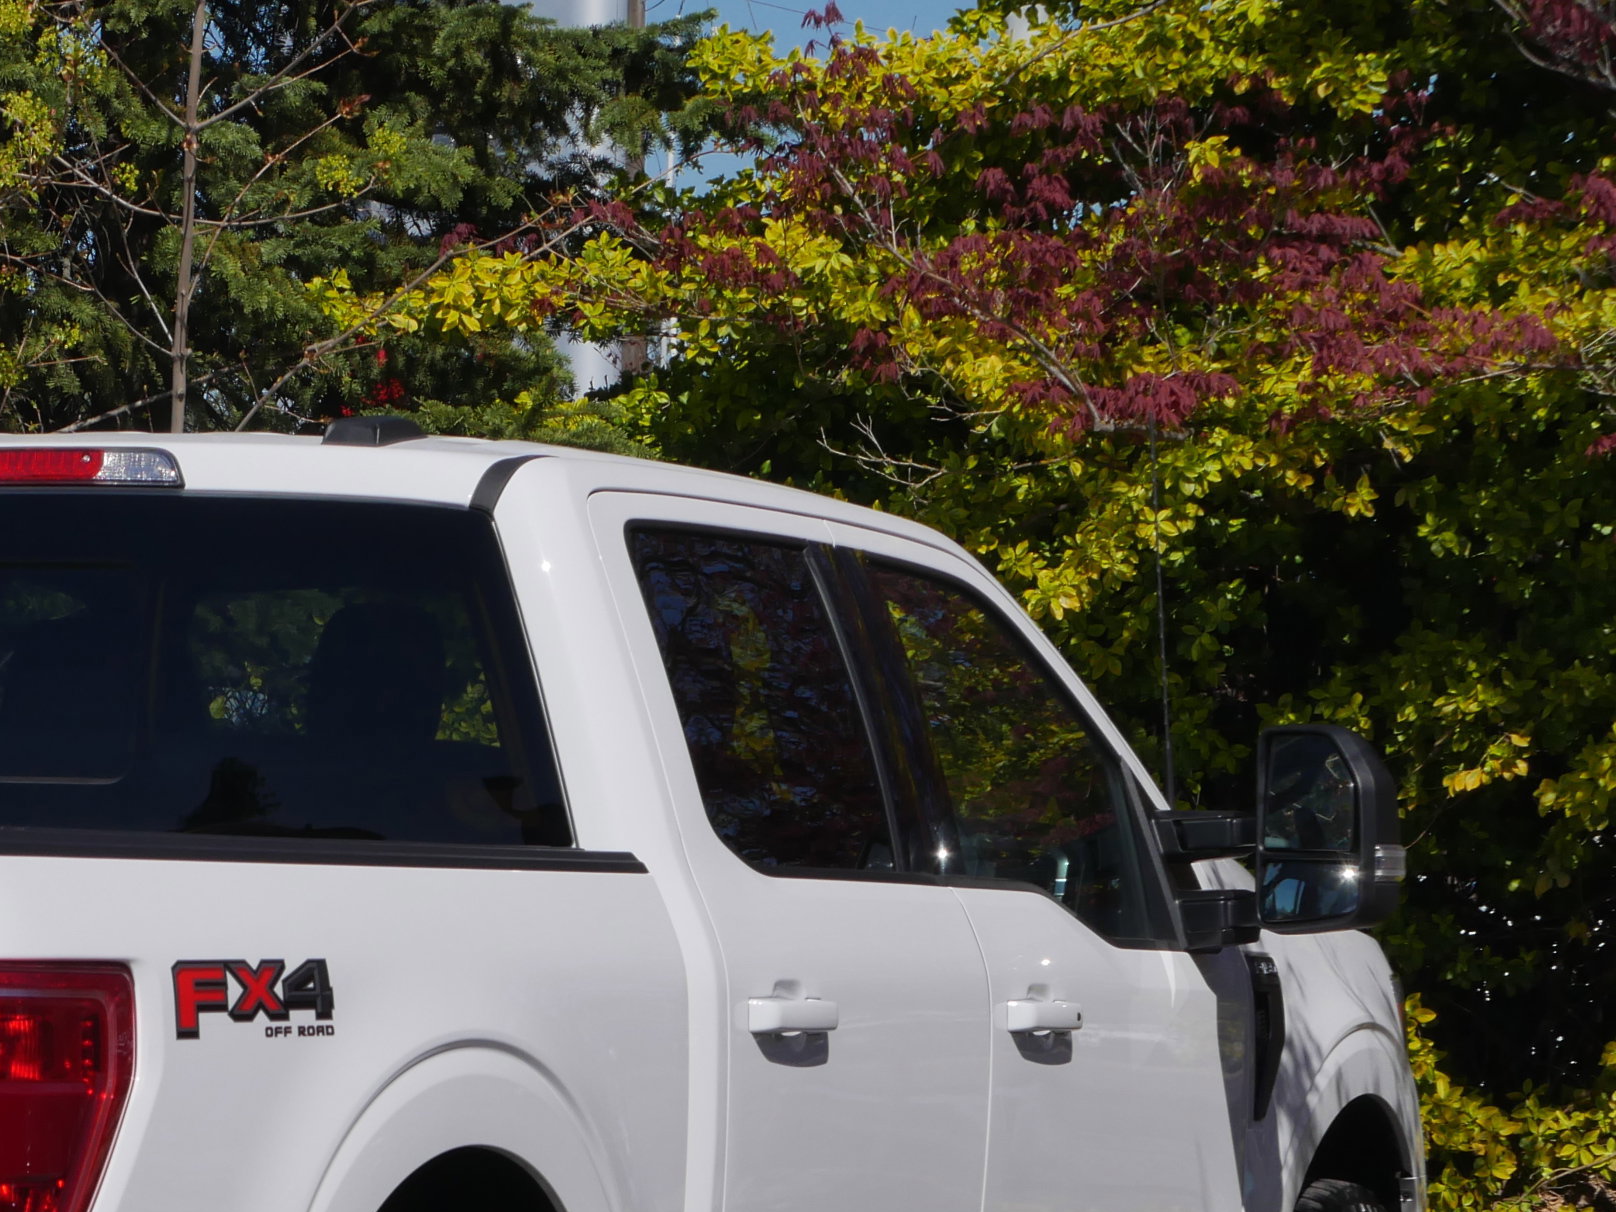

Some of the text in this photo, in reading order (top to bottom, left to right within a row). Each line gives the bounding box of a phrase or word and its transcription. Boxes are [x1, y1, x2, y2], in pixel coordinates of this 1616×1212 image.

[171, 958, 335, 1040] FX4
[264, 1025, 335, 1038] OFF ROAD
